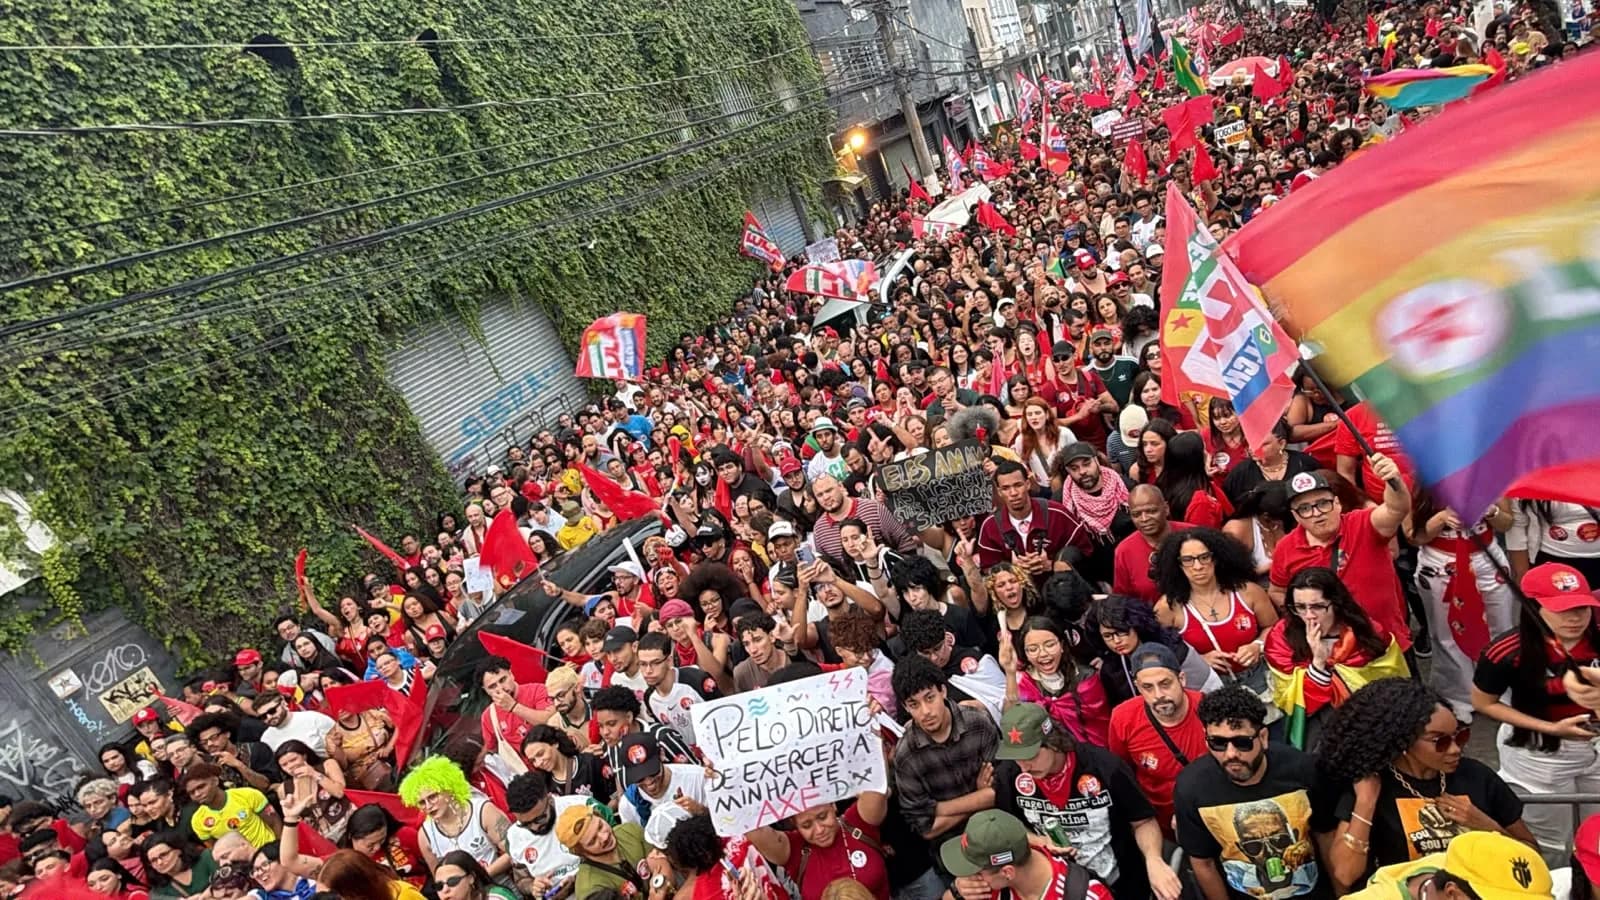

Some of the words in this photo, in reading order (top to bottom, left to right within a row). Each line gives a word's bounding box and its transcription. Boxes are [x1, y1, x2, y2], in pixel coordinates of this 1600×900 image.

[882, 453, 931, 492] ELES
[700, 703, 787, 759] PELO
[711, 768, 736, 792] DE
[744, 739, 844, 783] EXERCER
[852, 733, 870, 755] A
[1019, 798, 1042, 812] rage
[1046, 798, 1087, 812] aginst
[1420, 838, 1441, 851] SOU
